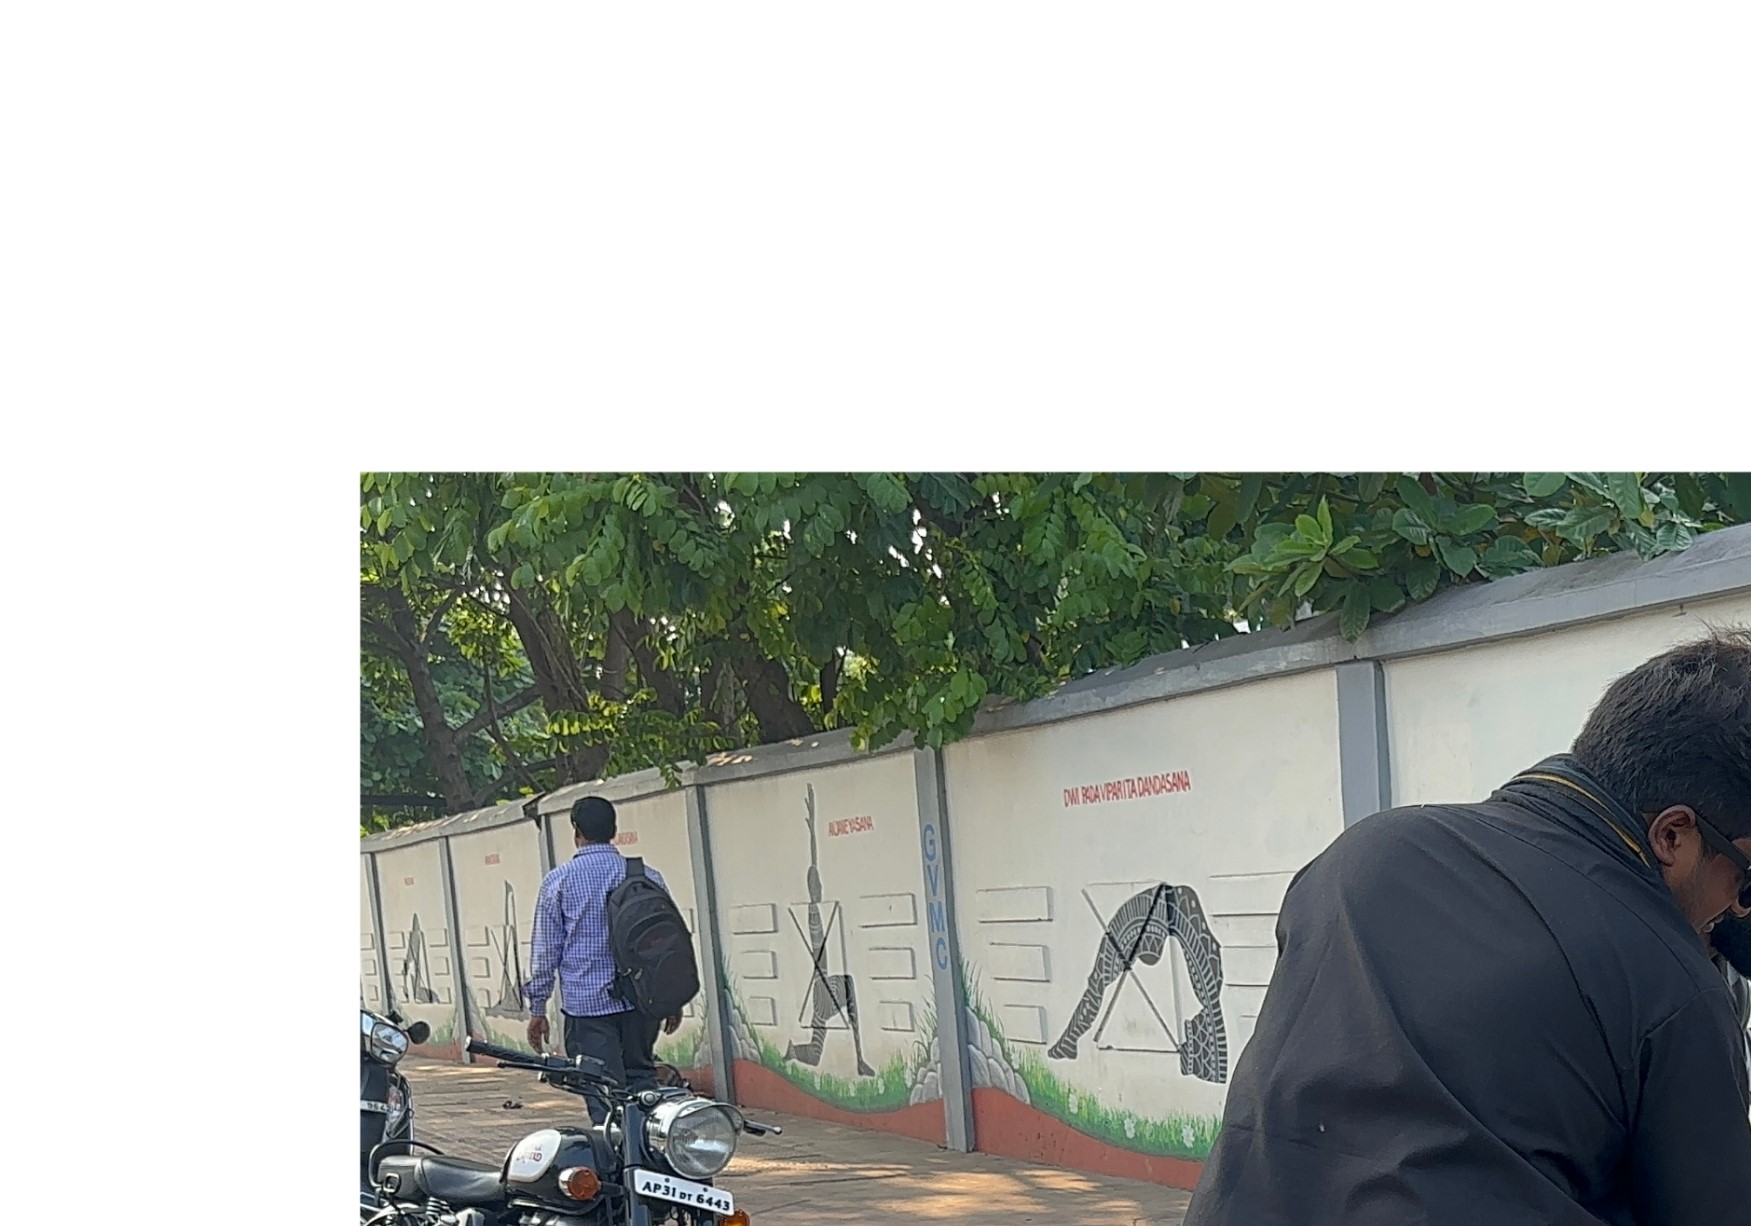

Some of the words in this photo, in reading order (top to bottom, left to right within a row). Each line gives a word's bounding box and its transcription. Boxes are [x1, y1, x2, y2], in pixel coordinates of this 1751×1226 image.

[1063, 787, 1080, 807] DWI
[1137, 770, 1191, 797] DANDASANA
[923, 823, 948, 970] GVMC
[642, 1181, 676, 1198] AP31
[696, 1194, 730, 1211] 6443
